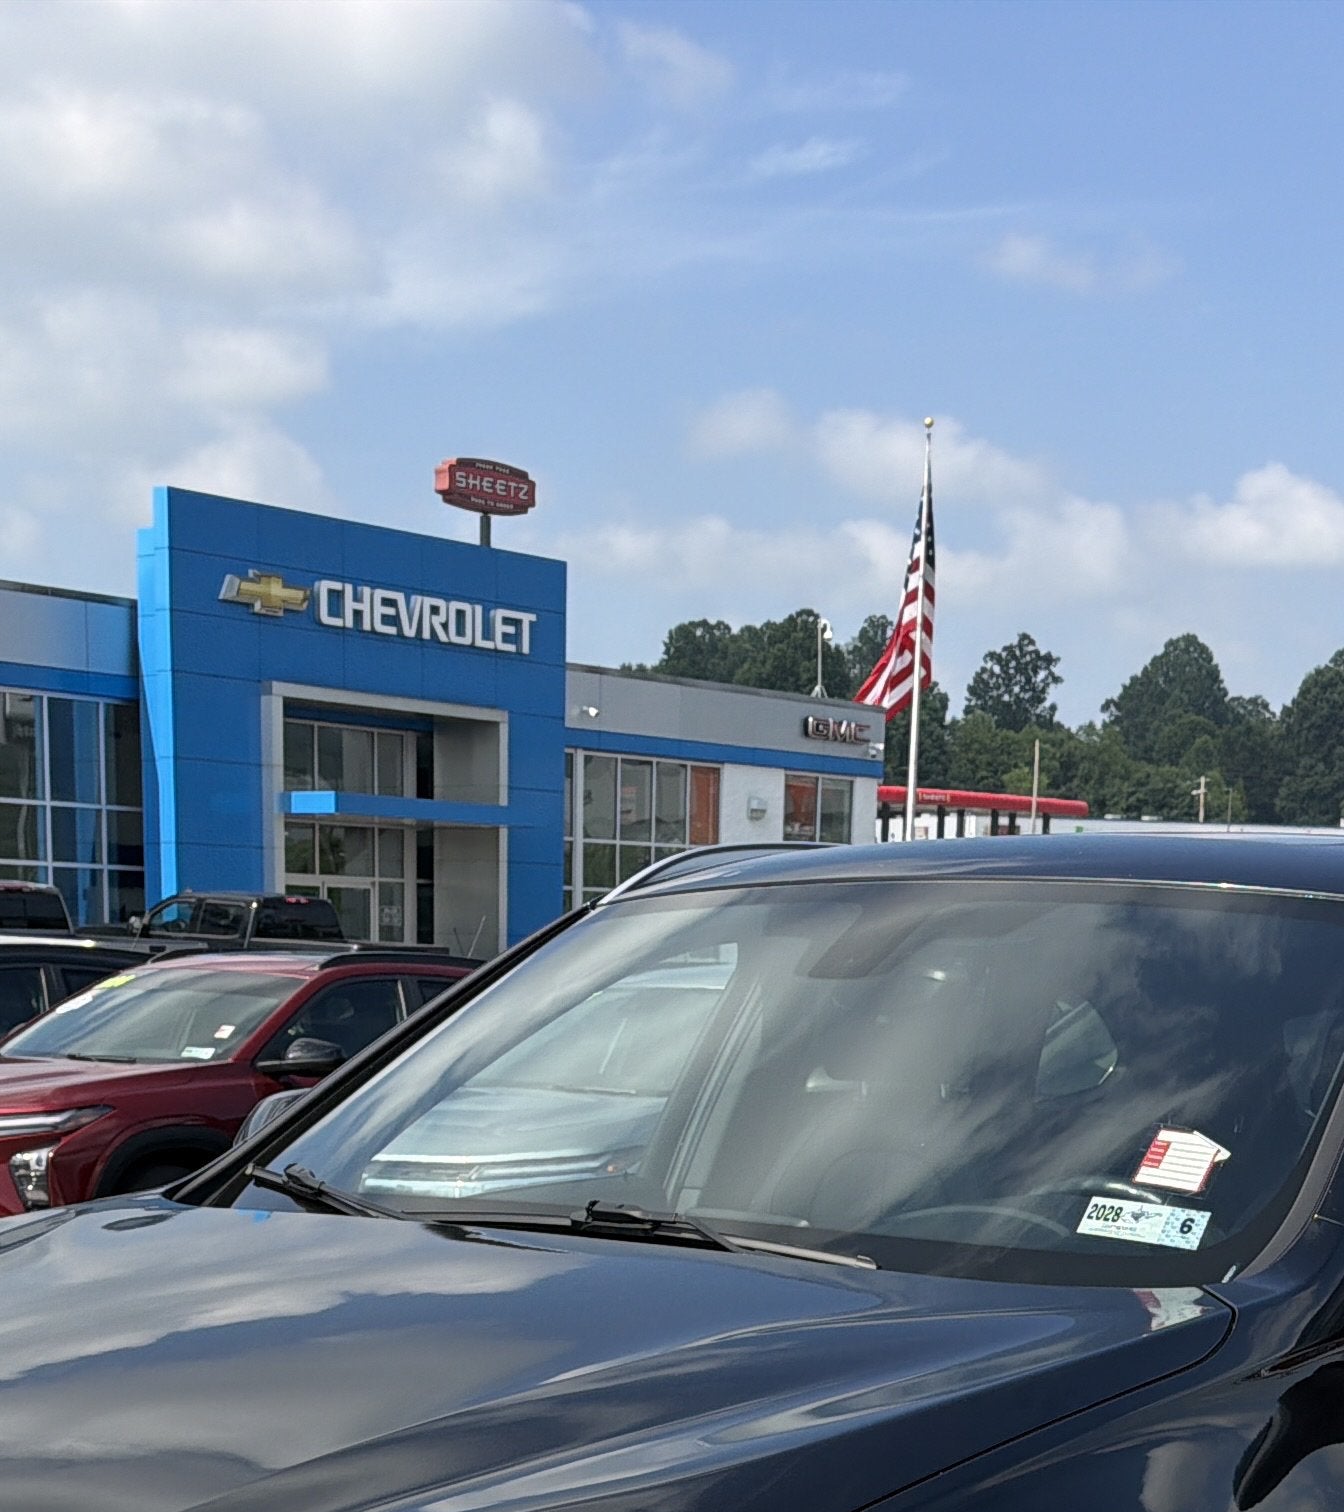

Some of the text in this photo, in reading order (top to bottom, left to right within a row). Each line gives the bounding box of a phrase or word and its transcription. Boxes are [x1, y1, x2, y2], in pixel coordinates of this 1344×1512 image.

[455, 471, 529, 500] SHEETZ
[314, 579, 537, 655] CHEVROLET
[804, 714, 872, 744] GMC
[1087, 1203, 1196, 1235] 2028 6
